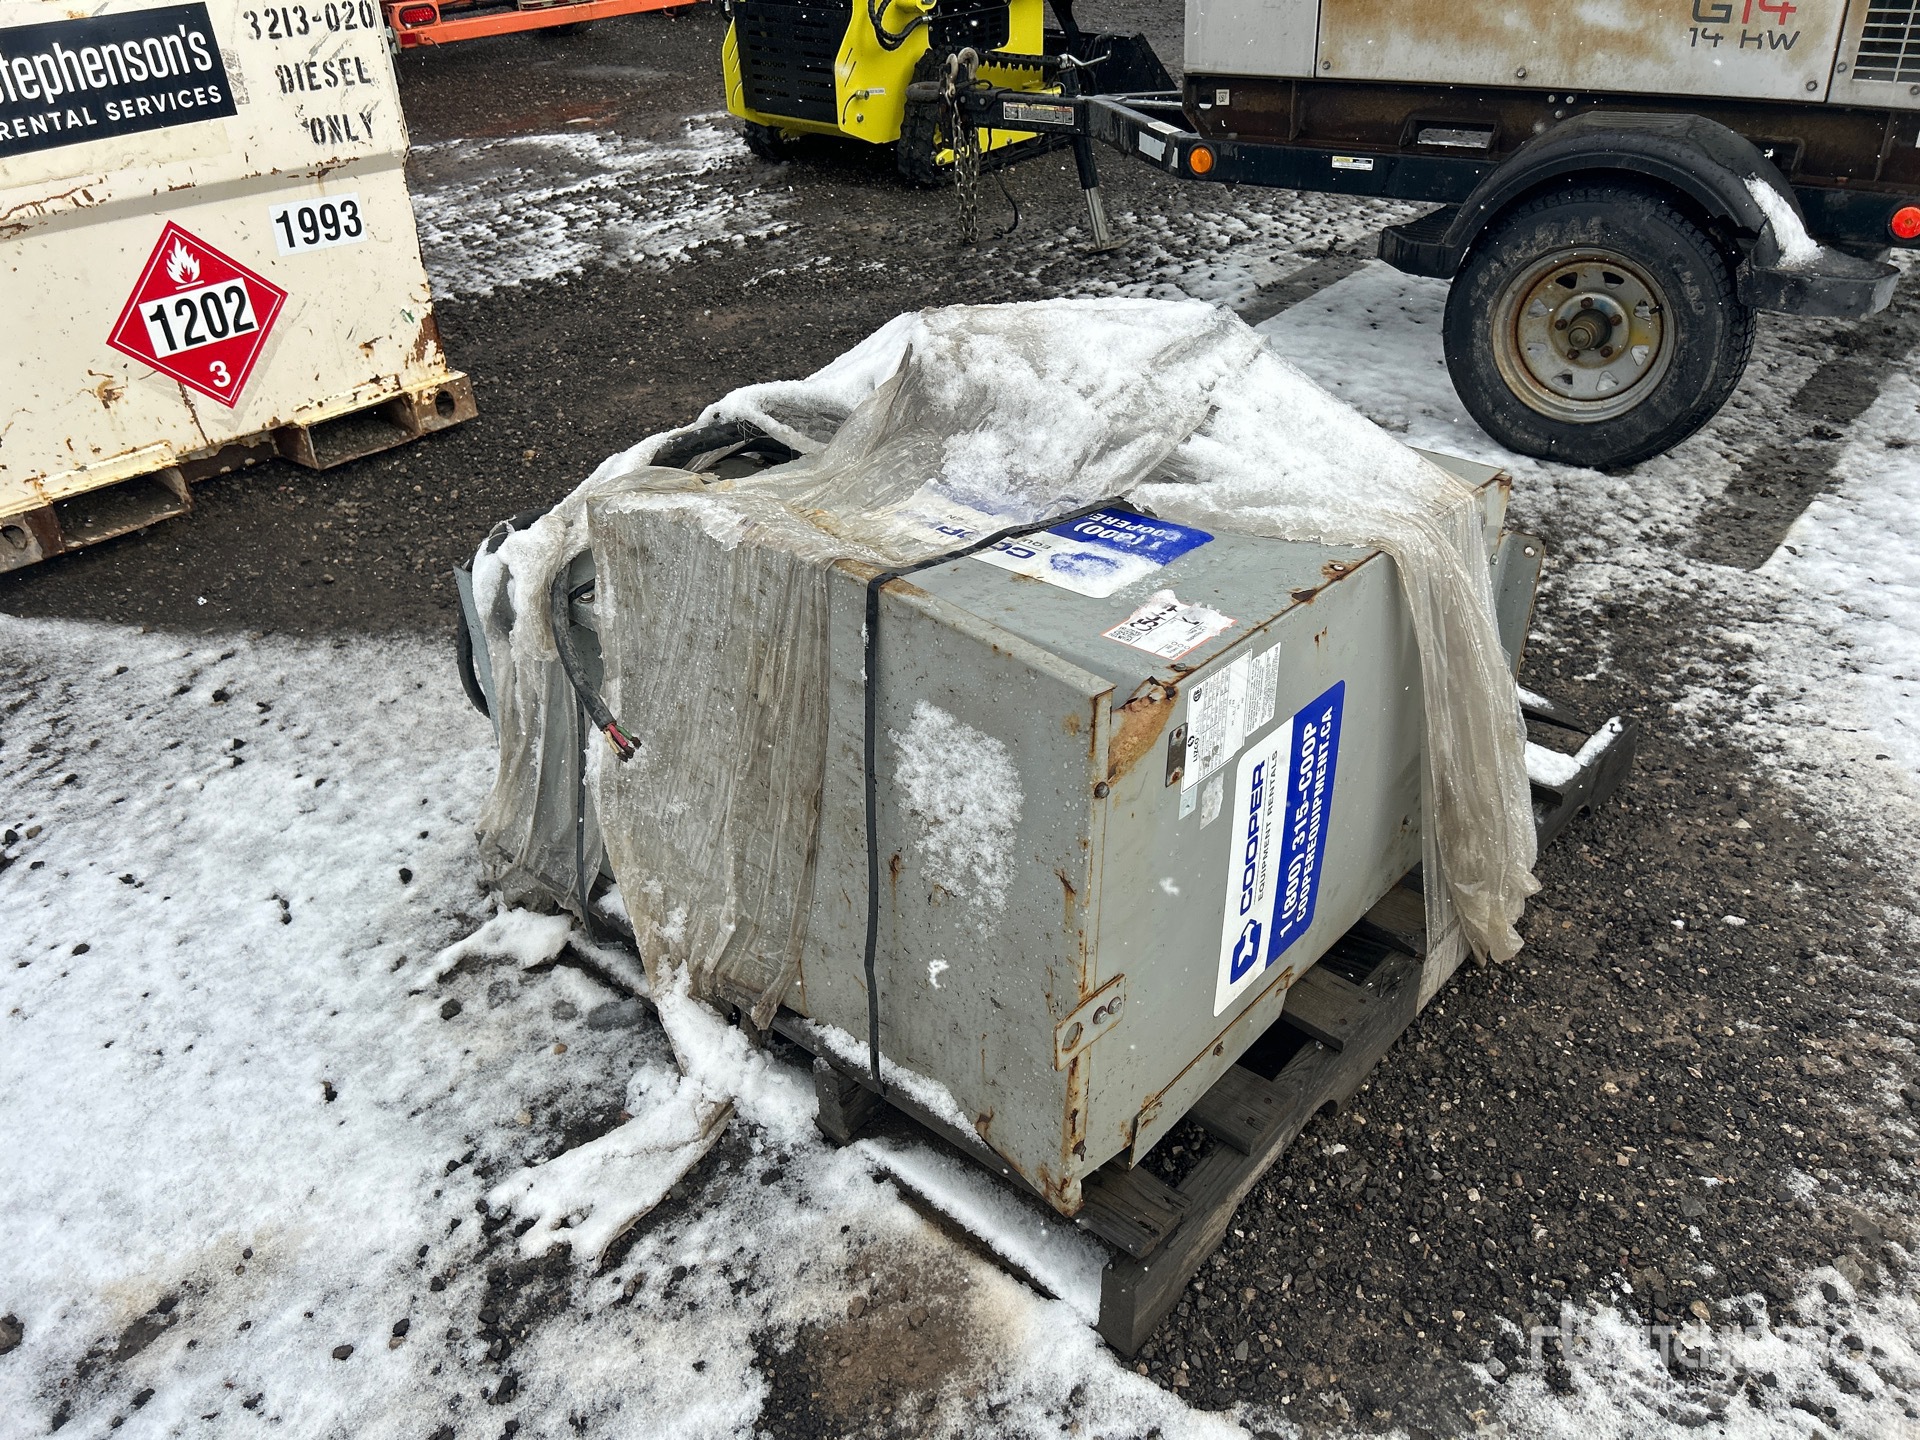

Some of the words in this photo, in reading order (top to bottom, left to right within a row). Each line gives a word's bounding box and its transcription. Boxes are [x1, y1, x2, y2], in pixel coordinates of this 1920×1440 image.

[242, 0, 375, 41] 3213-020
[1688, 27, 1724, 48] 14
[0, 24, 213, 104] tephenson's
[275, 55, 373, 95] DIESEL
[0, 106, 98, 141] RENTAL
[105, 84, 223, 122] SERVICES
[309, 113, 374, 146] ONLY
[274, 199, 363, 249] 1993
[149, 284, 255, 352] 1202
[208, 360, 232, 388] 3
[1291, 721, 1318, 852] 315-COOP
[1296, 705, 1334, 924] COOPEREQUIPMENT.CA
[1240, 759, 1265, 917] COOPER
[1257, 821, 1272, 902] EQUIPMENT
[1267, 750, 1278, 817] RENTALS
[1281, 852, 1299, 922] (800)
[1279, 920, 1293, 939] 1
